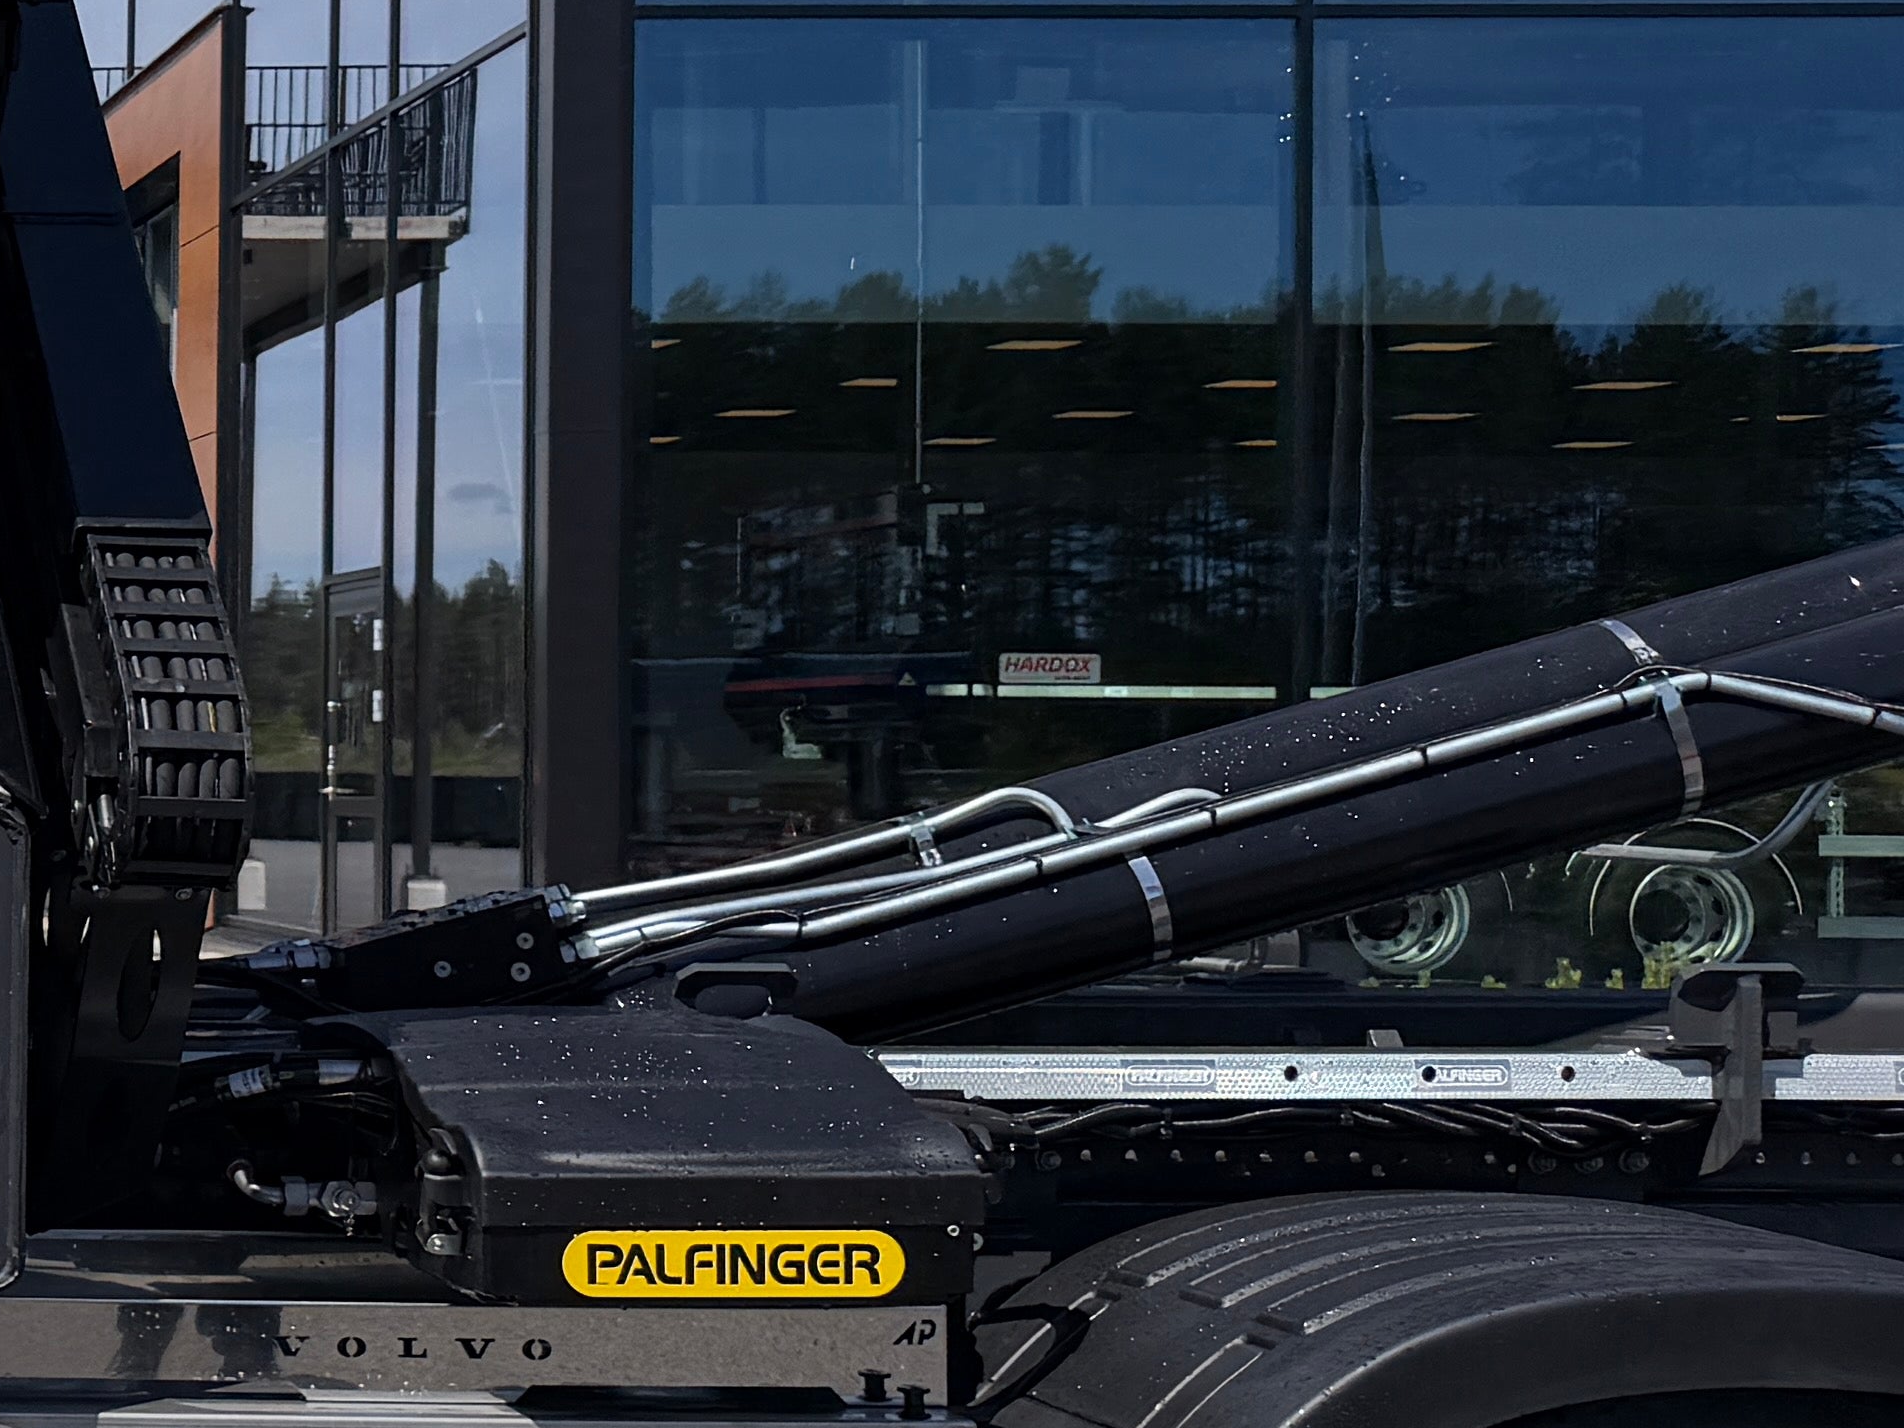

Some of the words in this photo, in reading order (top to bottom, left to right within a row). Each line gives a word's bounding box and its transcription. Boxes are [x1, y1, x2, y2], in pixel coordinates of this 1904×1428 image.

[1004, 655, 1091, 673] HARDOX
[1429, 1066, 1504, 1084] ALFINGER
[587, 1243, 882, 1285] PALFINGER
[893, 1319, 937, 1345] AP
[274, 1336, 553, 1361] VOLVO
